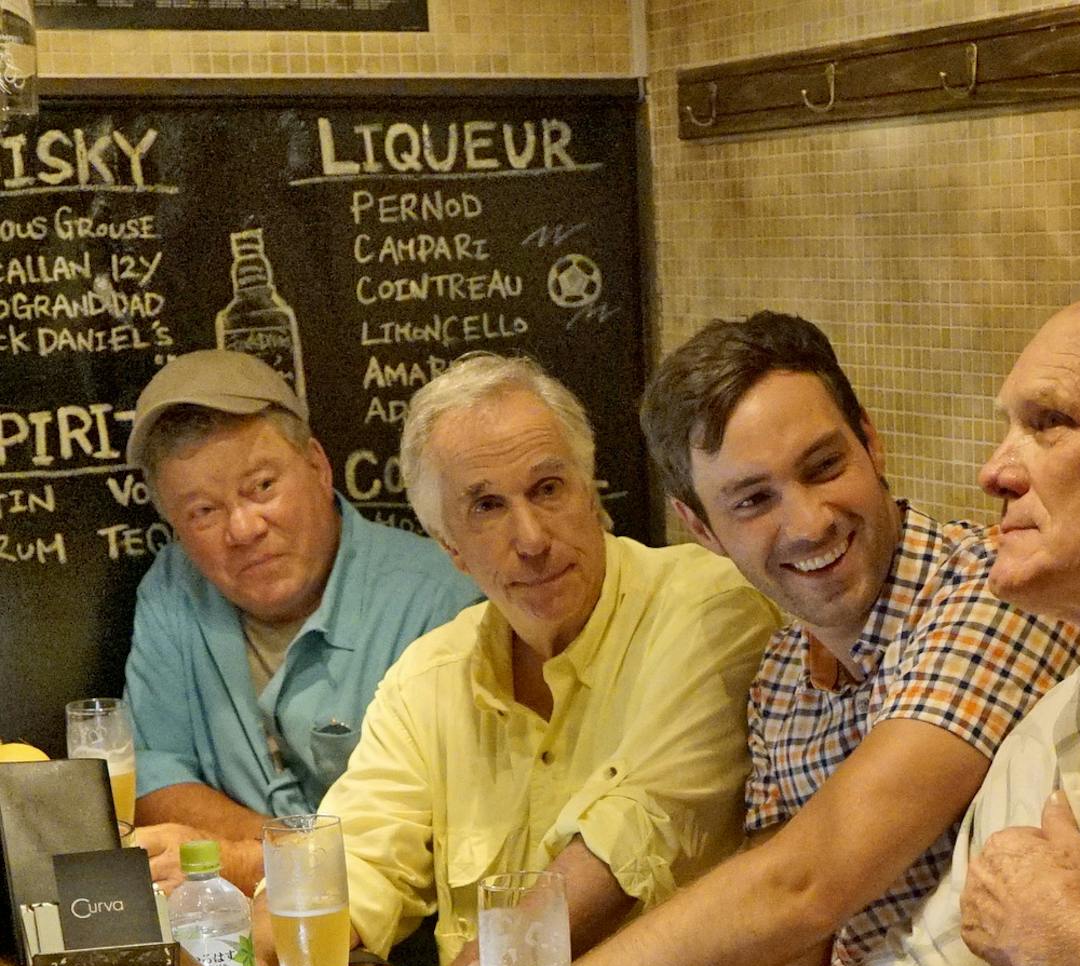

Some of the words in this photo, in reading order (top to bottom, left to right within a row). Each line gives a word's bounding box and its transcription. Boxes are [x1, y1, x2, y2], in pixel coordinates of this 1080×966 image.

[317, 117, 577, 175] LIQUEUR
[352, 190, 482, 223] PERNOD
[353, 233, 490, 266] CAMPARI
[356, 269, 523, 304] COINTREAU
[38, 320, 173, 356] DANIEL'S
[361, 312, 529, 347] LIMONCELLO
[71, 897, 124, 919] Curva
